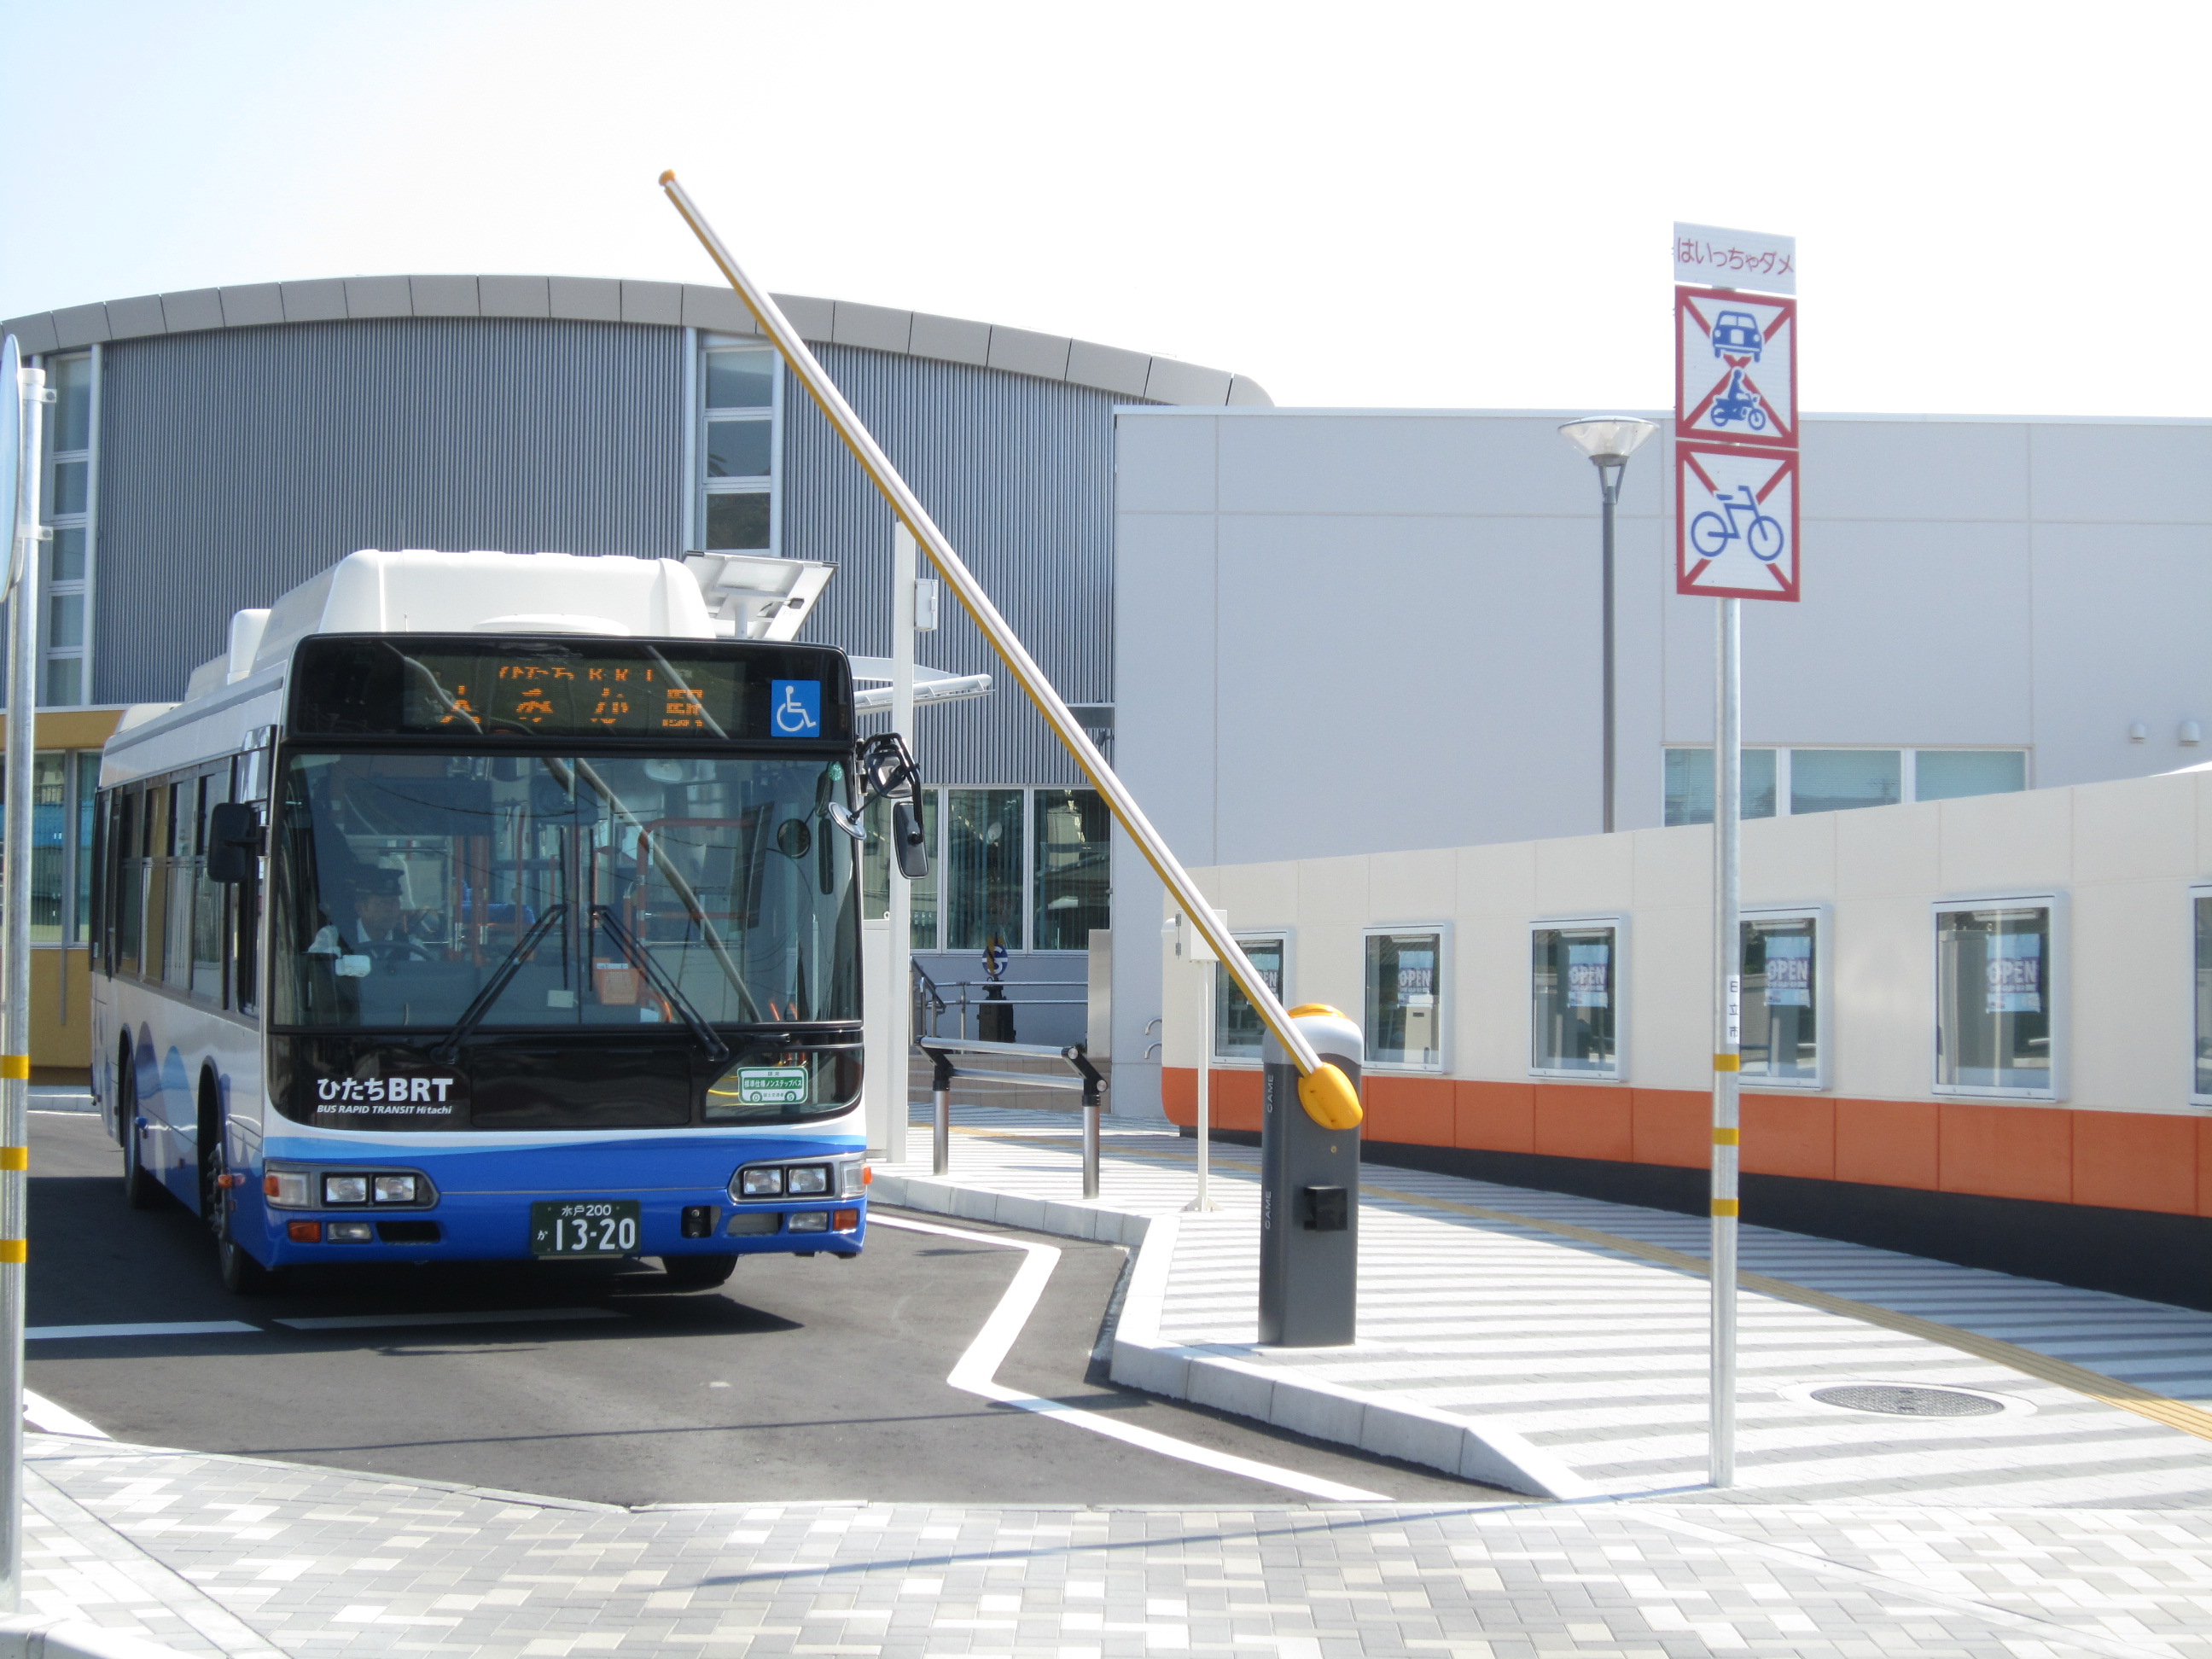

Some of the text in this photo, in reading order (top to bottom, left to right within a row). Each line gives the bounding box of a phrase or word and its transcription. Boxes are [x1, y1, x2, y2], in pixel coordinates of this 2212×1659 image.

[1677, 236, 1794, 276] はいっちゃダメ
[1399, 969, 1432, 987] OPEN
[1569, 965, 1606, 984] OPEN
[1767, 959, 1808, 981] OPEN
[1988, 960, 2037, 984] OPEN
[317, 1104, 452, 1115] BUS RAPID TRANSIT Hitachi
[537, 1218, 636, 1251] か 13-20
